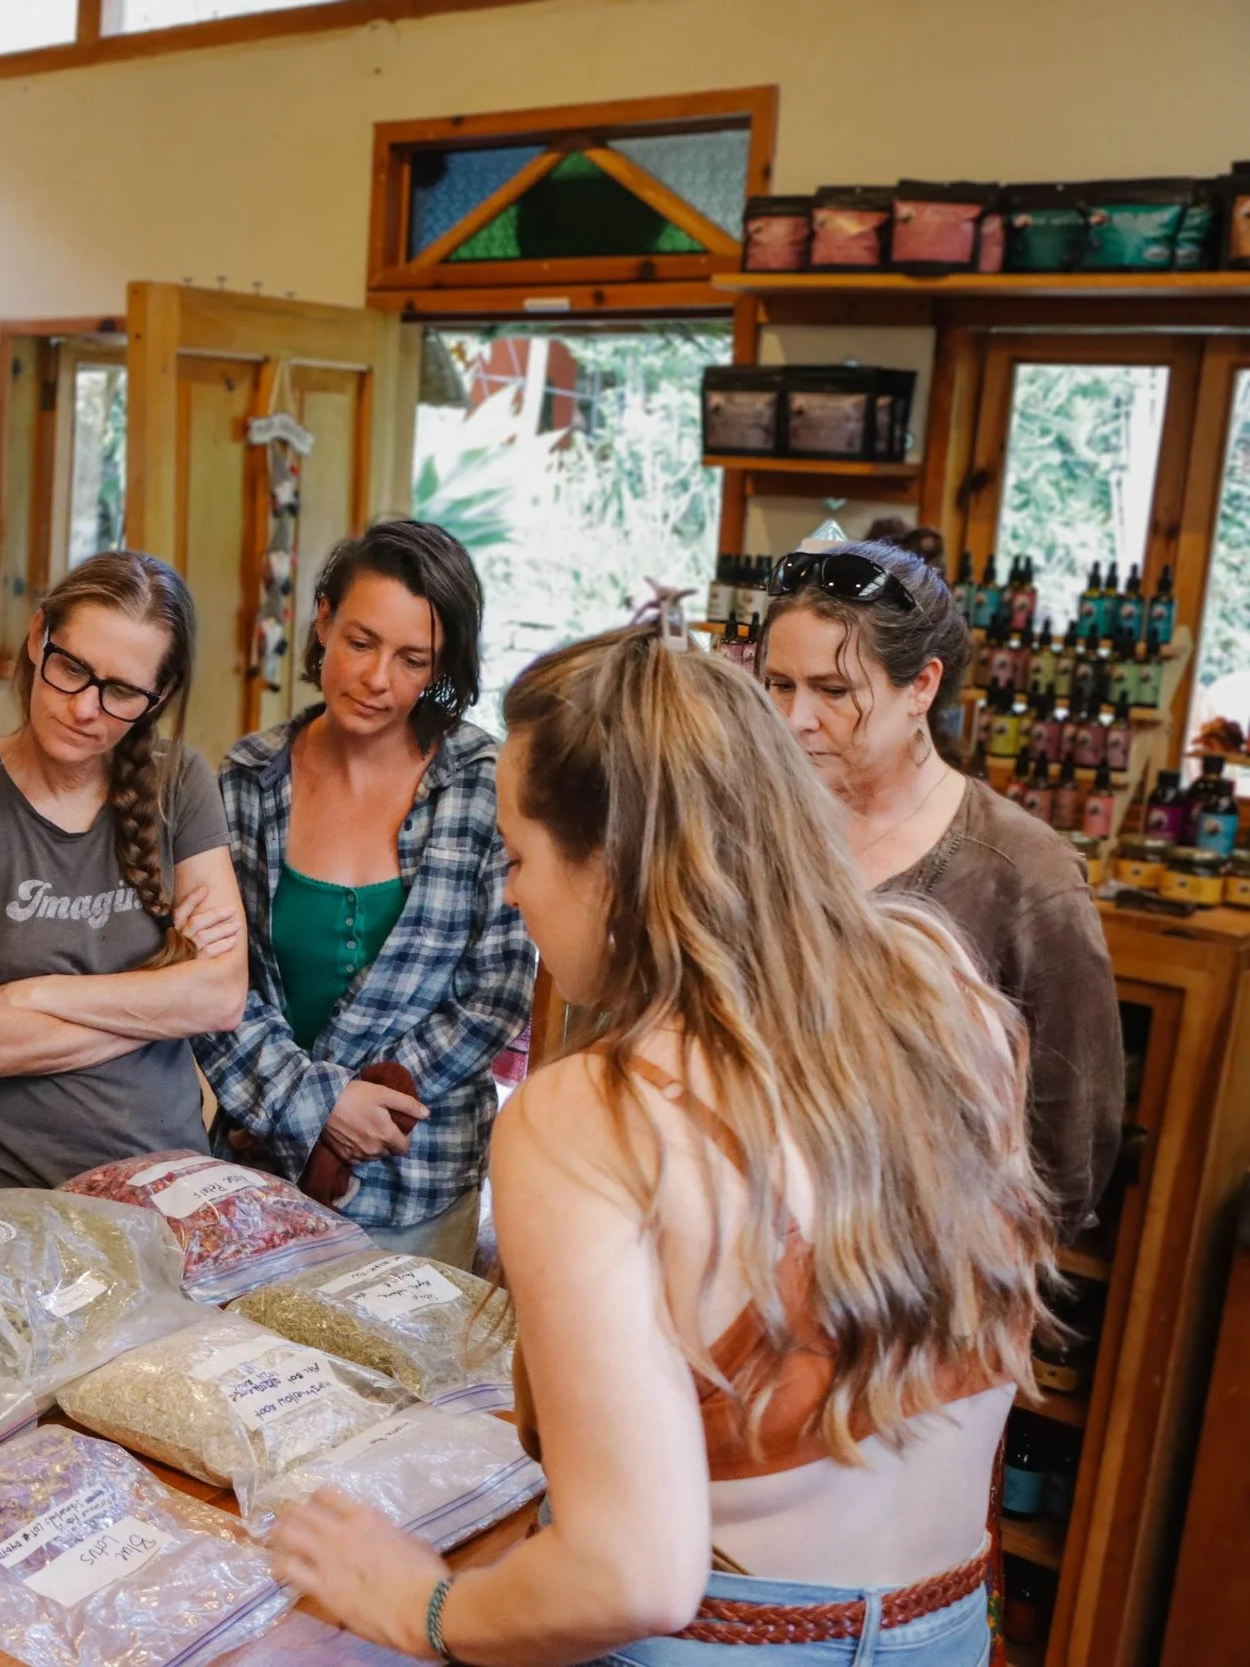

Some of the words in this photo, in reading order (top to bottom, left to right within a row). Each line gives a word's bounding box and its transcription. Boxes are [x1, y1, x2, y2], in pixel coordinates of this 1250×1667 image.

[193, 1182, 227, 1198] Petals
[80, 1534, 119, 1567] Lotus
[114, 1534, 157, 1562] Blue
